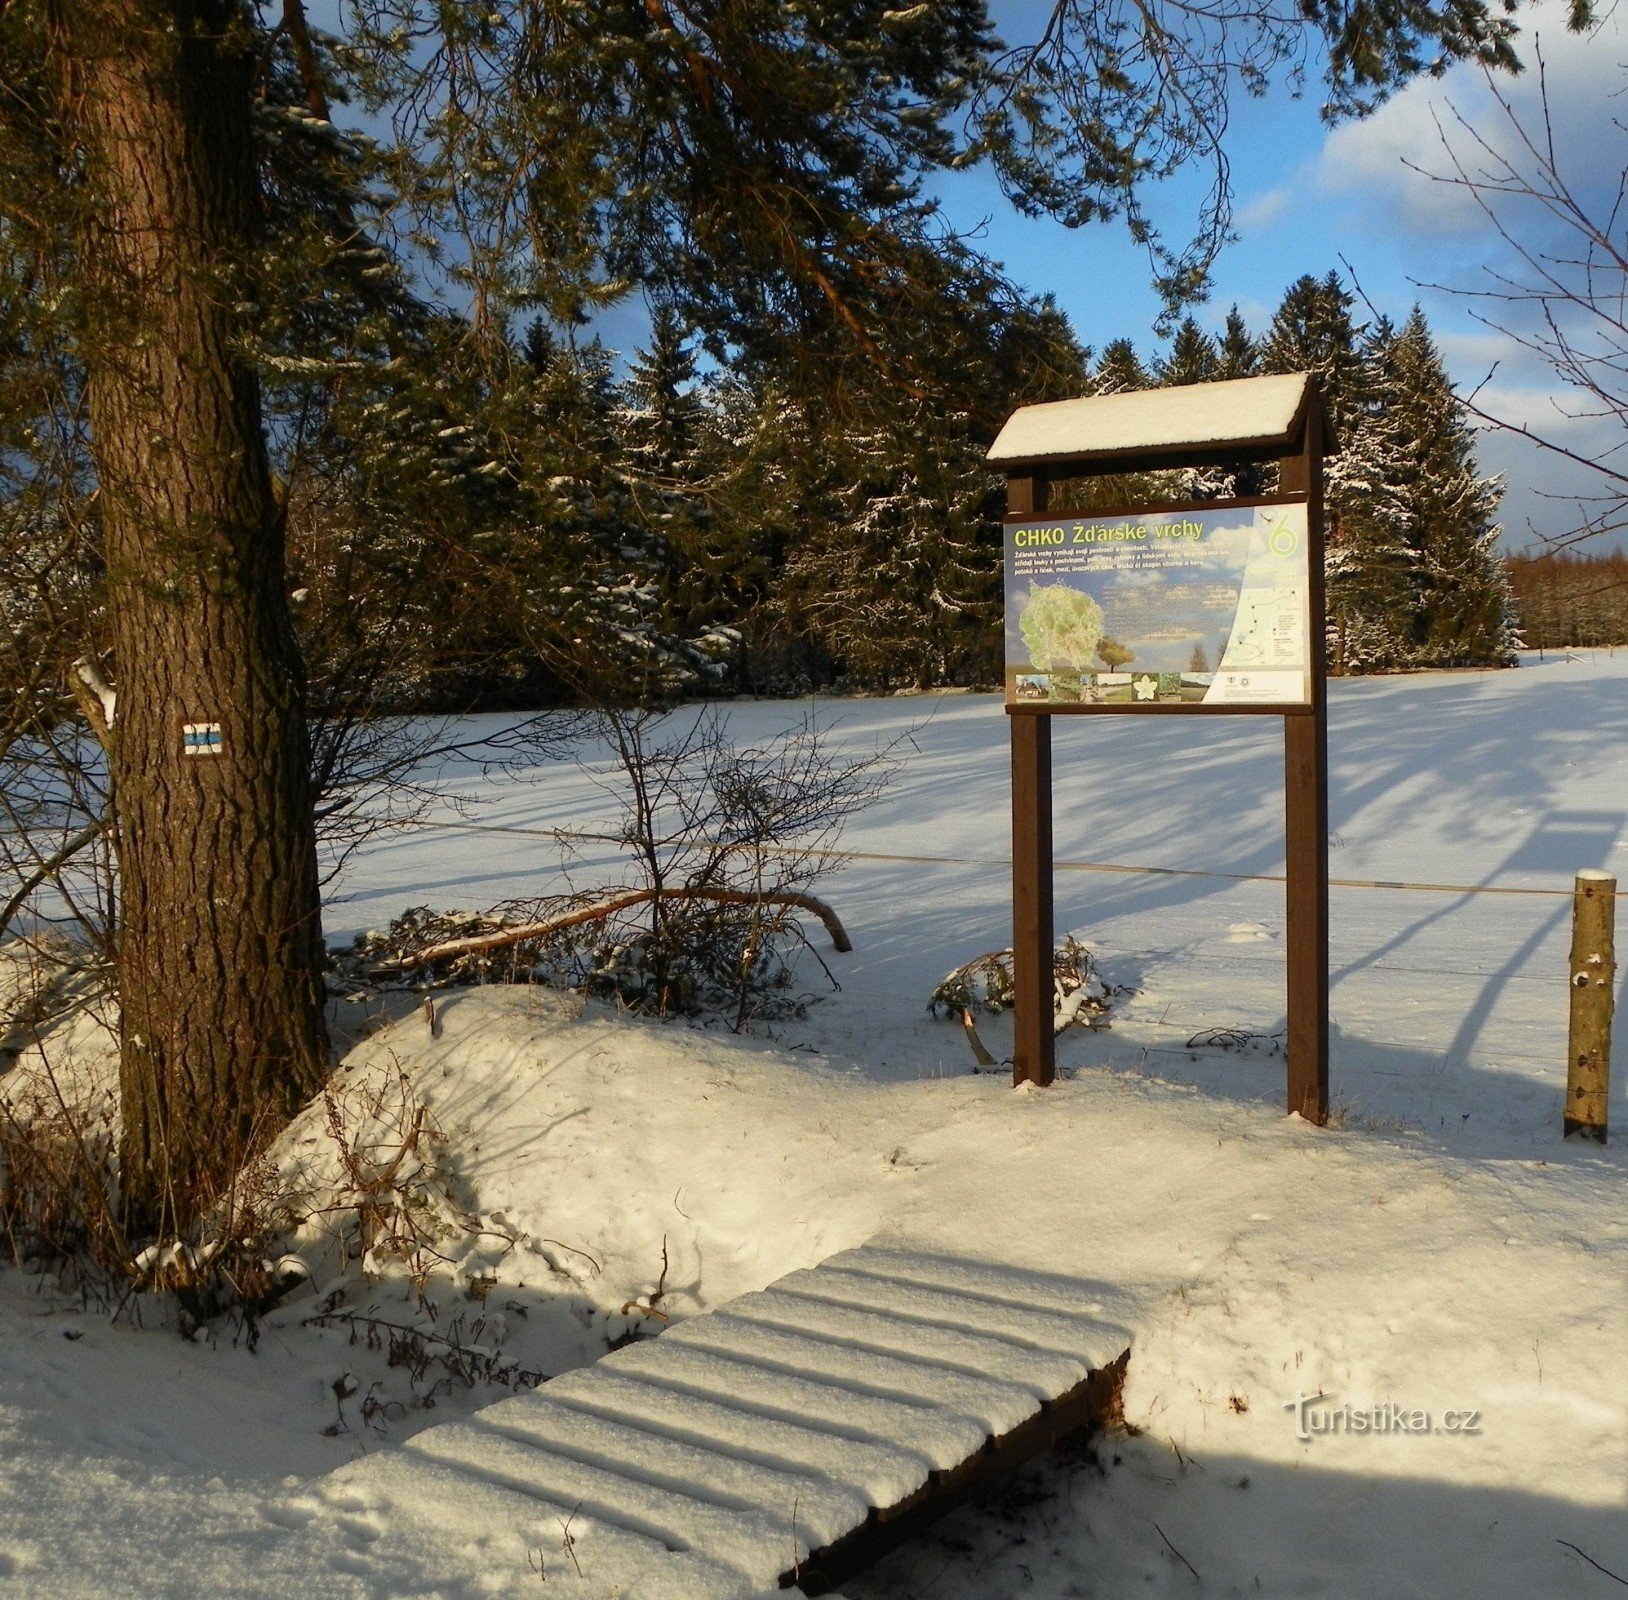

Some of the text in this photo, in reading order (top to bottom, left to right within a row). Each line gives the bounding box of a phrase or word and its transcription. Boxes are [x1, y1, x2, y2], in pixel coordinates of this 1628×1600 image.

[1014, 519, 1204, 547] CHKO Žďárské vrchy
[1270, 512, 1298, 557] 6
